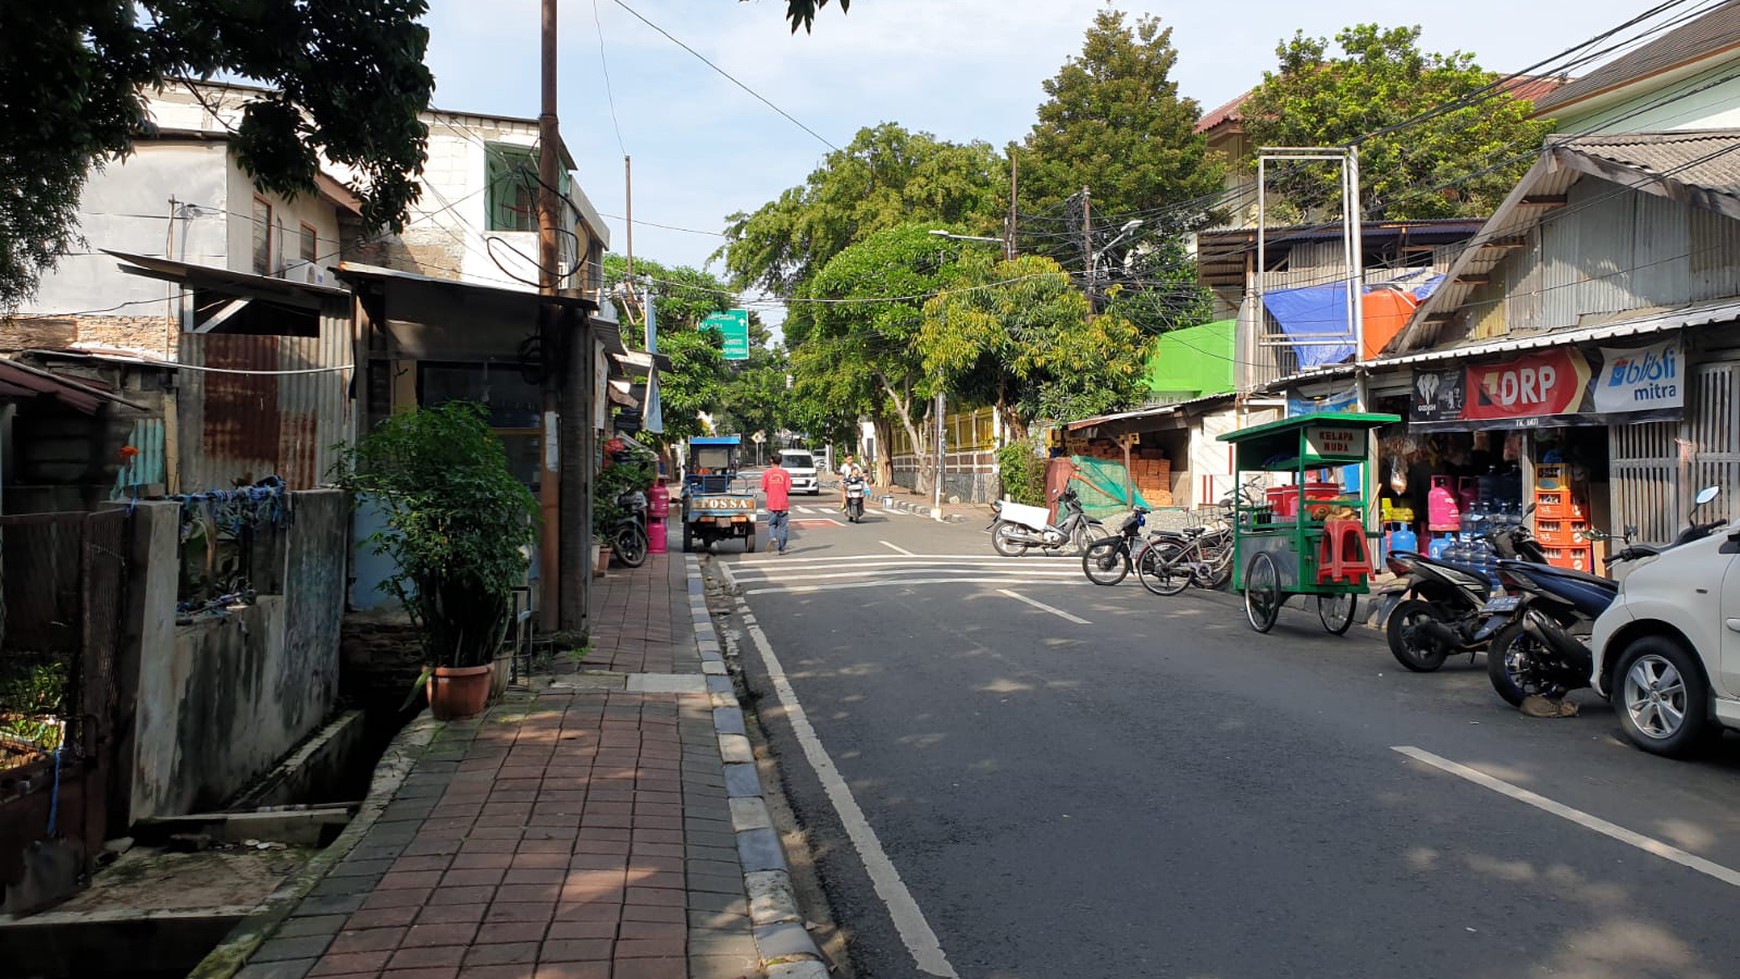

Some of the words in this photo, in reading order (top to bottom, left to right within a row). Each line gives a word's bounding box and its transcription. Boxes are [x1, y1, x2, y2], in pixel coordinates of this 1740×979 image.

[1634, 384, 1677, 401] mitra
[1320, 431, 1353, 441] KELAPA
[701, 499, 748, 509] TOSSA
